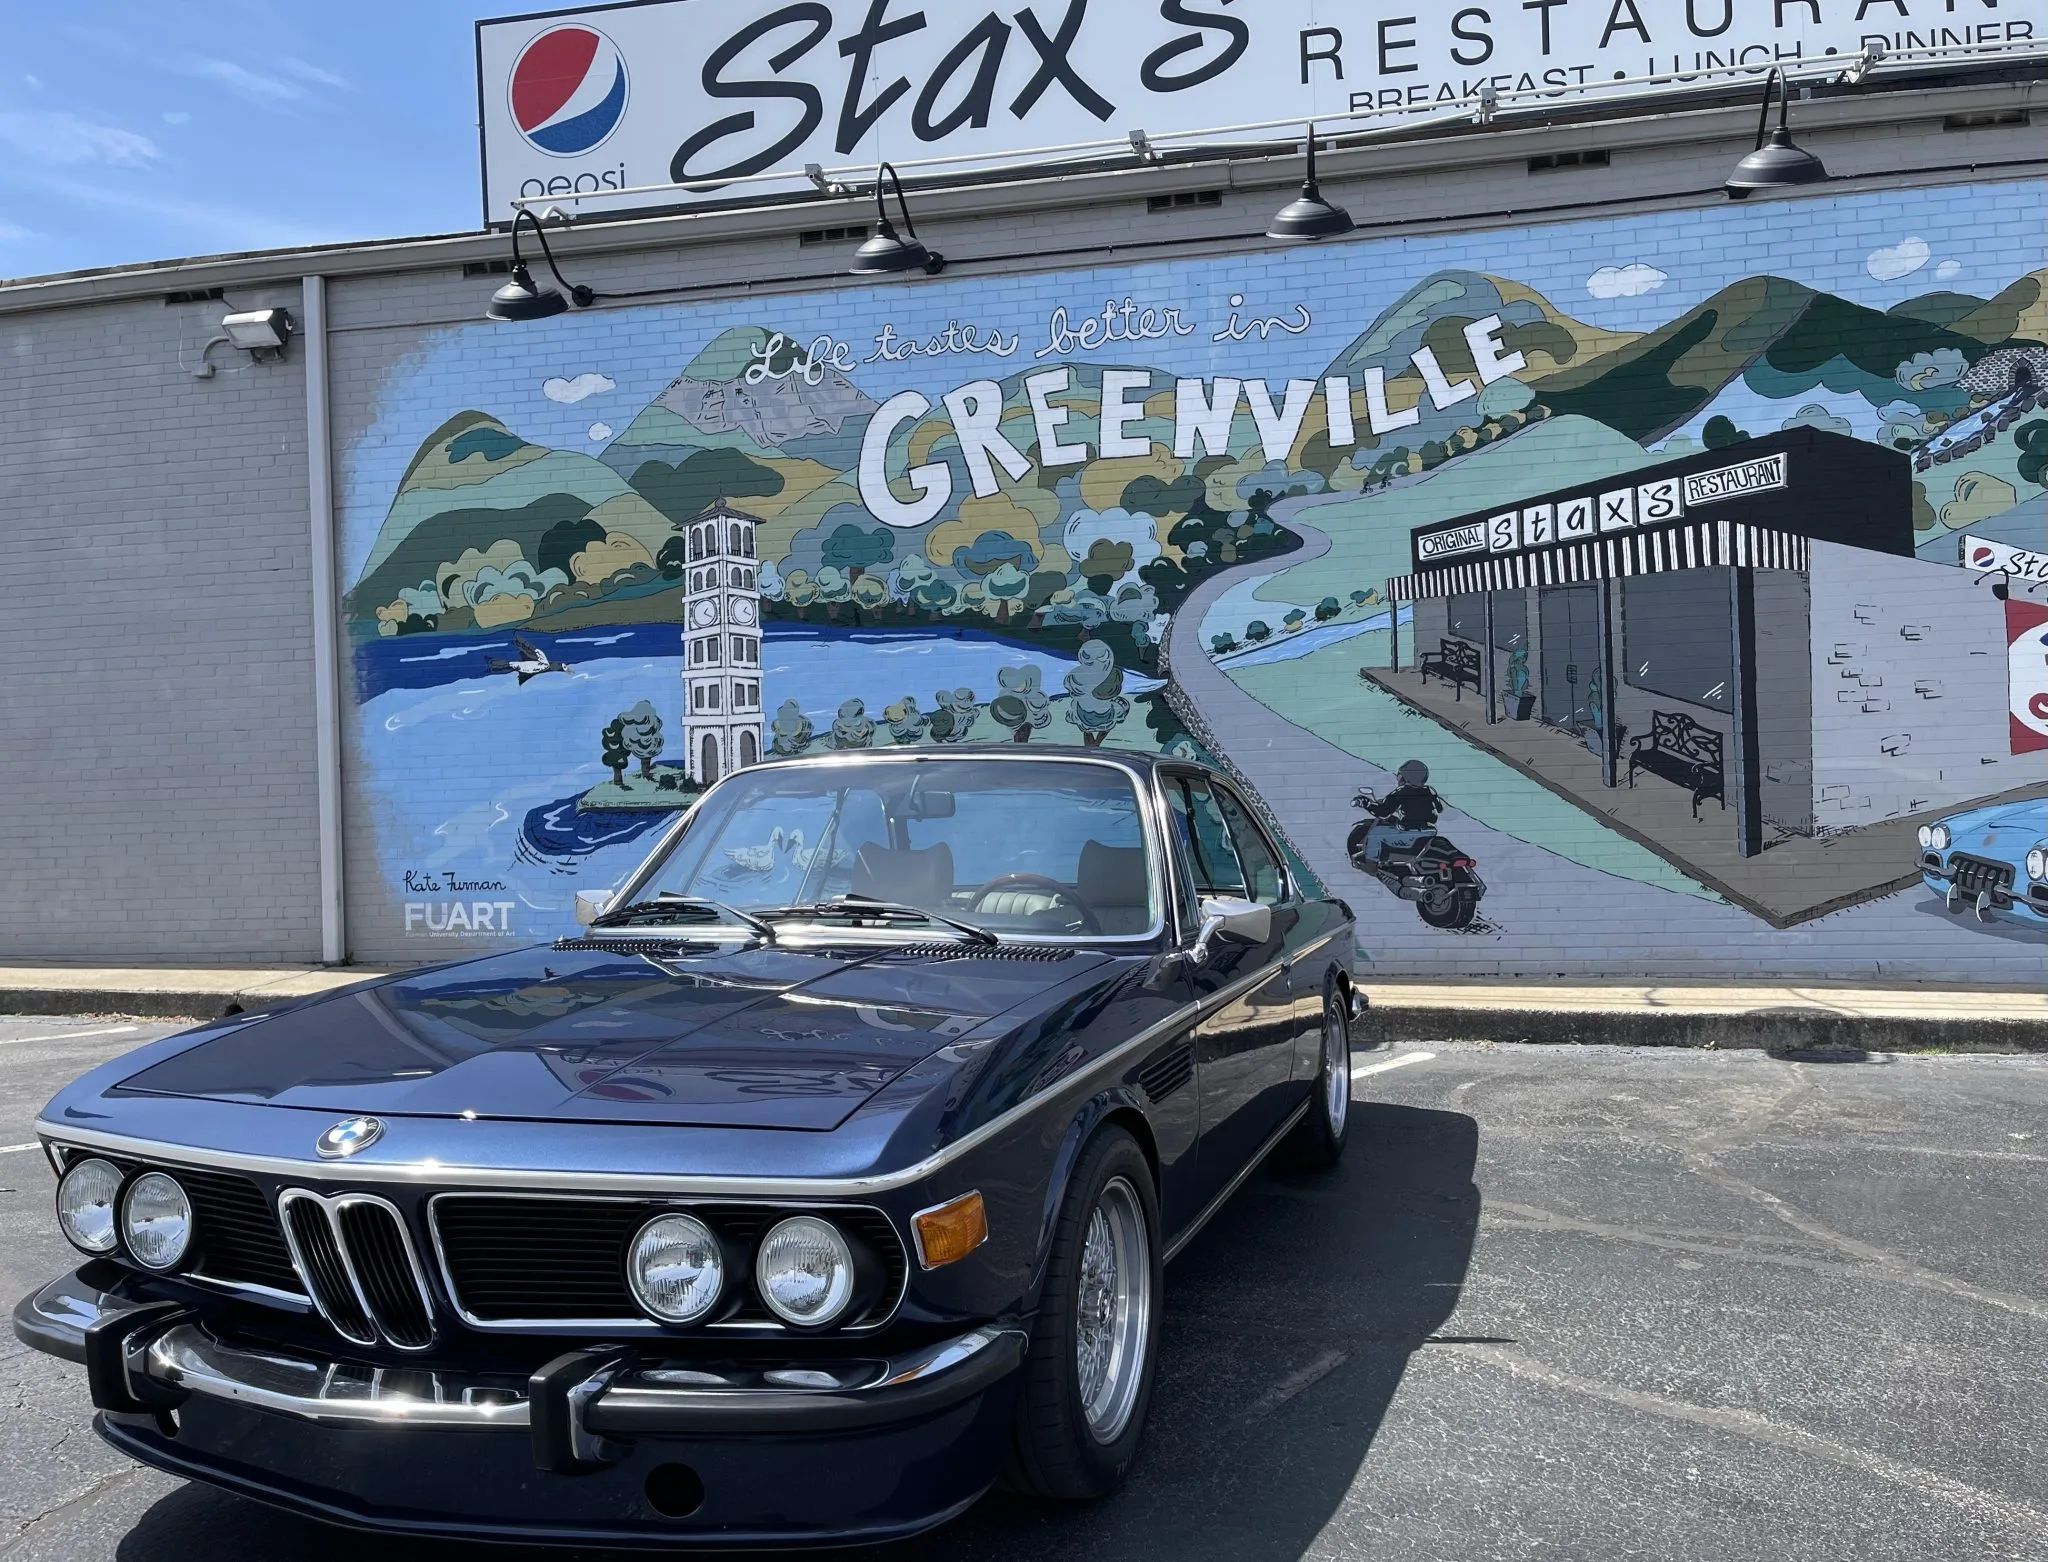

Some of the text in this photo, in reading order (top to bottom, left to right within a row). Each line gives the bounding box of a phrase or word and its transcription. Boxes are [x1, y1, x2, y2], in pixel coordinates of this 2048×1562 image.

[669, 0, 1250, 192] Staxs
[1349, 20, 2034, 120] BREAKFAST LUNCH DINNER
[520, 162, 625, 205] pepsi
[744, 293, 1311, 386] Life tastes better in
[857, 312, 1527, 528] GREENVILLE
[1422, 526, 1483, 555] ORIGINAL
[1689, 457, 1782, 500] RESTAURANT
[403, 870, 506, 893] Kate Furman
[405, 901, 516, 931] FUART
